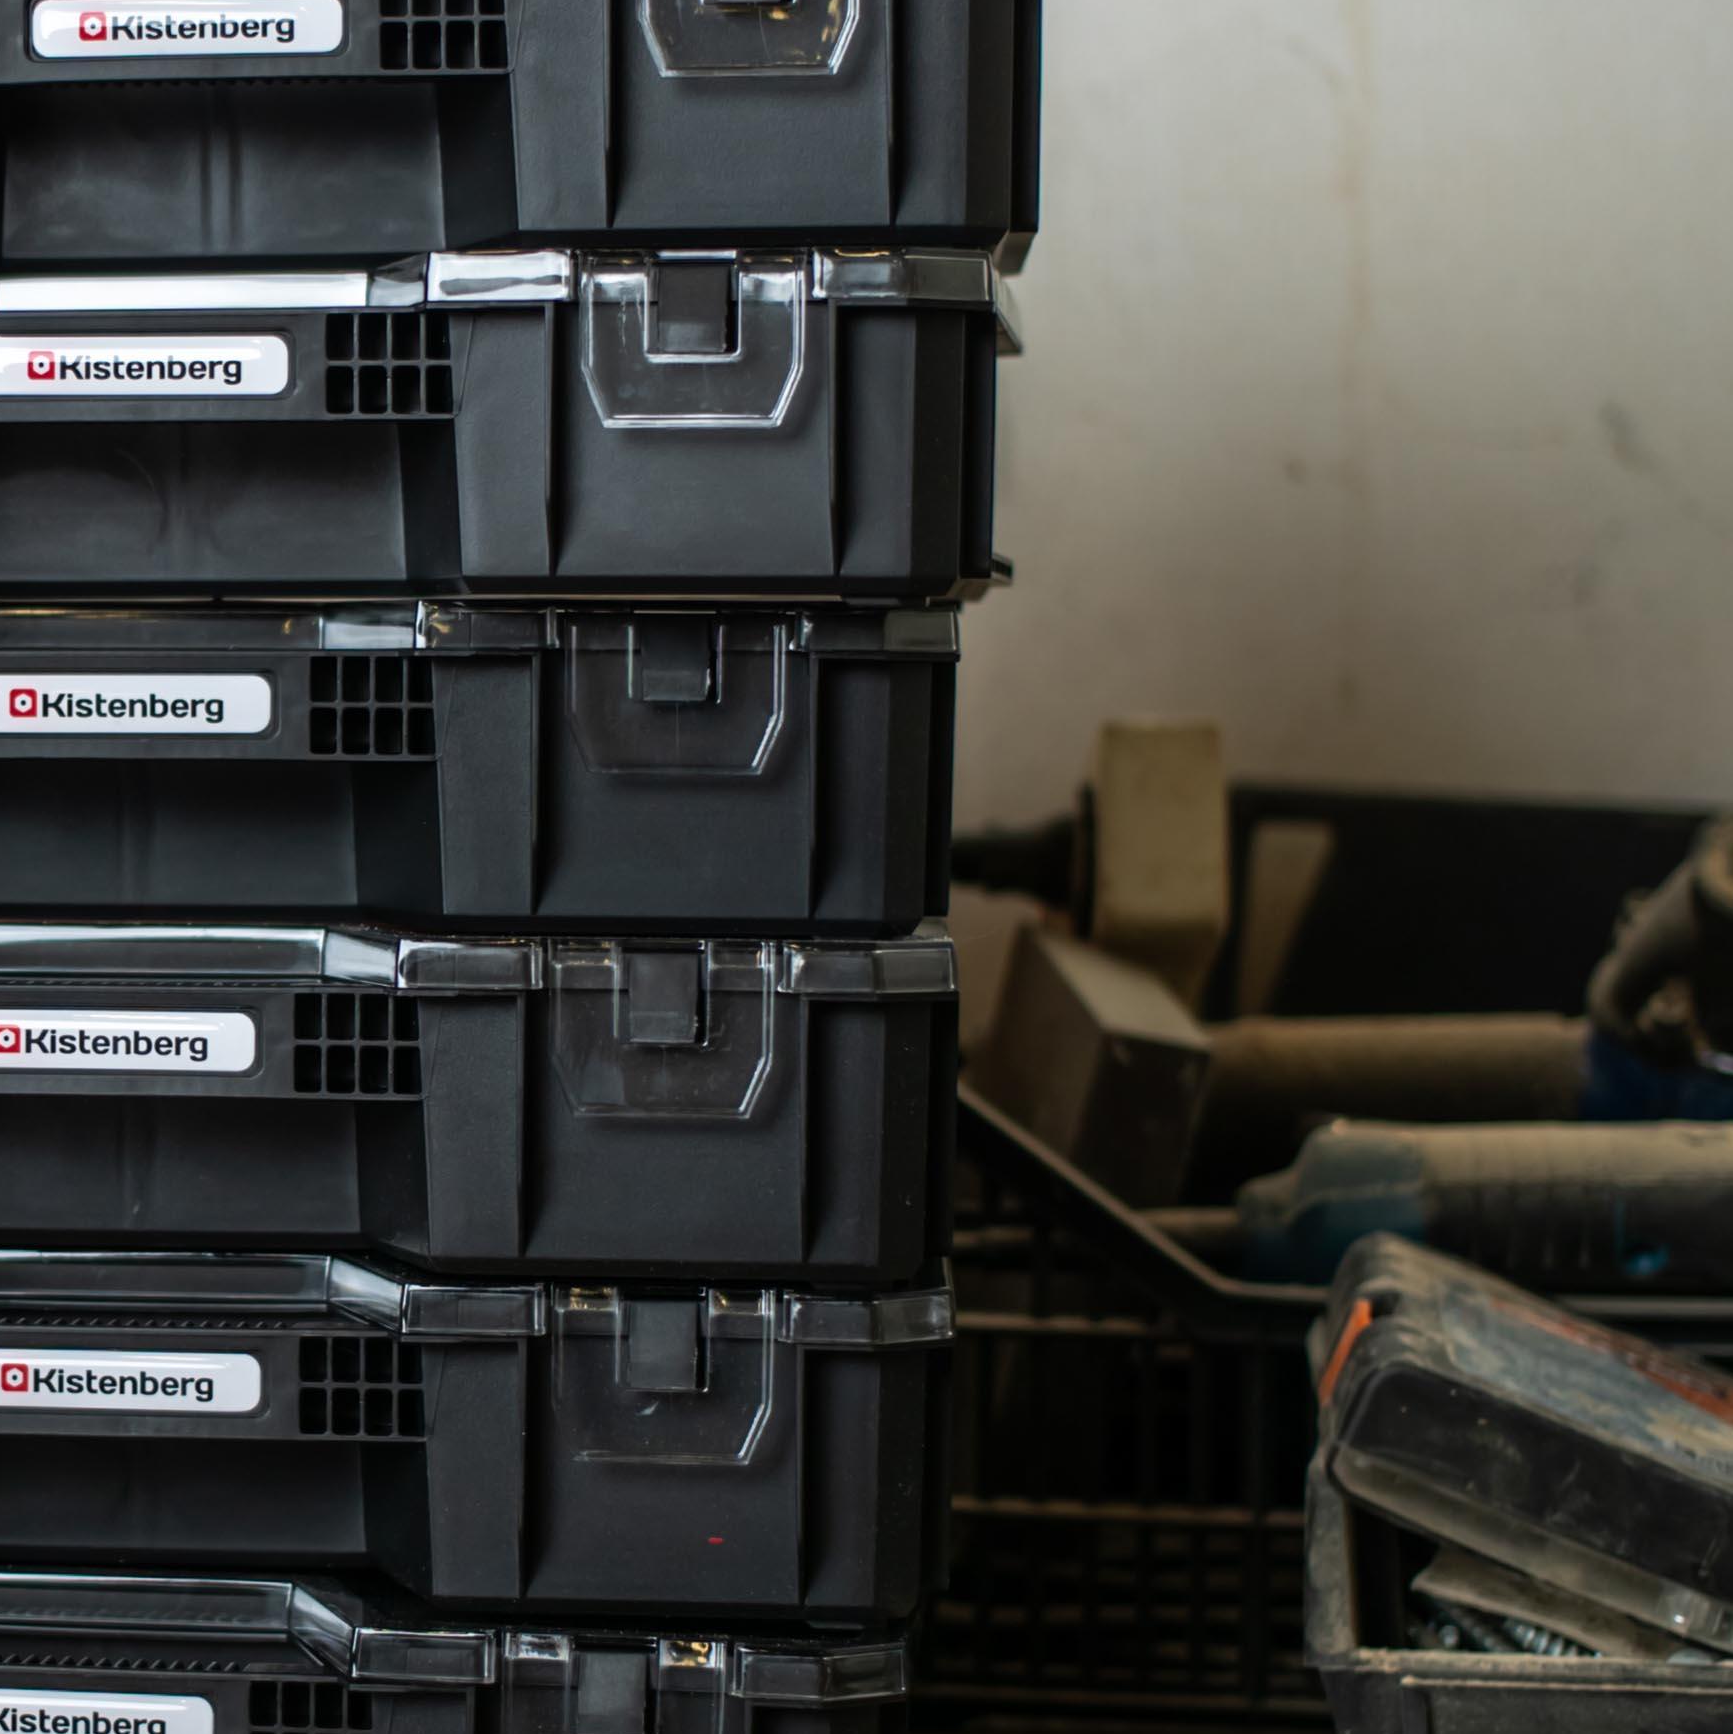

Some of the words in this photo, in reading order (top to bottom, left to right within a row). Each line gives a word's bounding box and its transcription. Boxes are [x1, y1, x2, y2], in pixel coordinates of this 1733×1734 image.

[111, 14, 295, 43] Kistenberg
[59, 353, 242, 386] Kistenberg
[42, 693, 224, 724] Kistenberg
[25, 1028, 208, 1062] Kistenberg
[33, 1368, 214, 1403] Kistenberg
